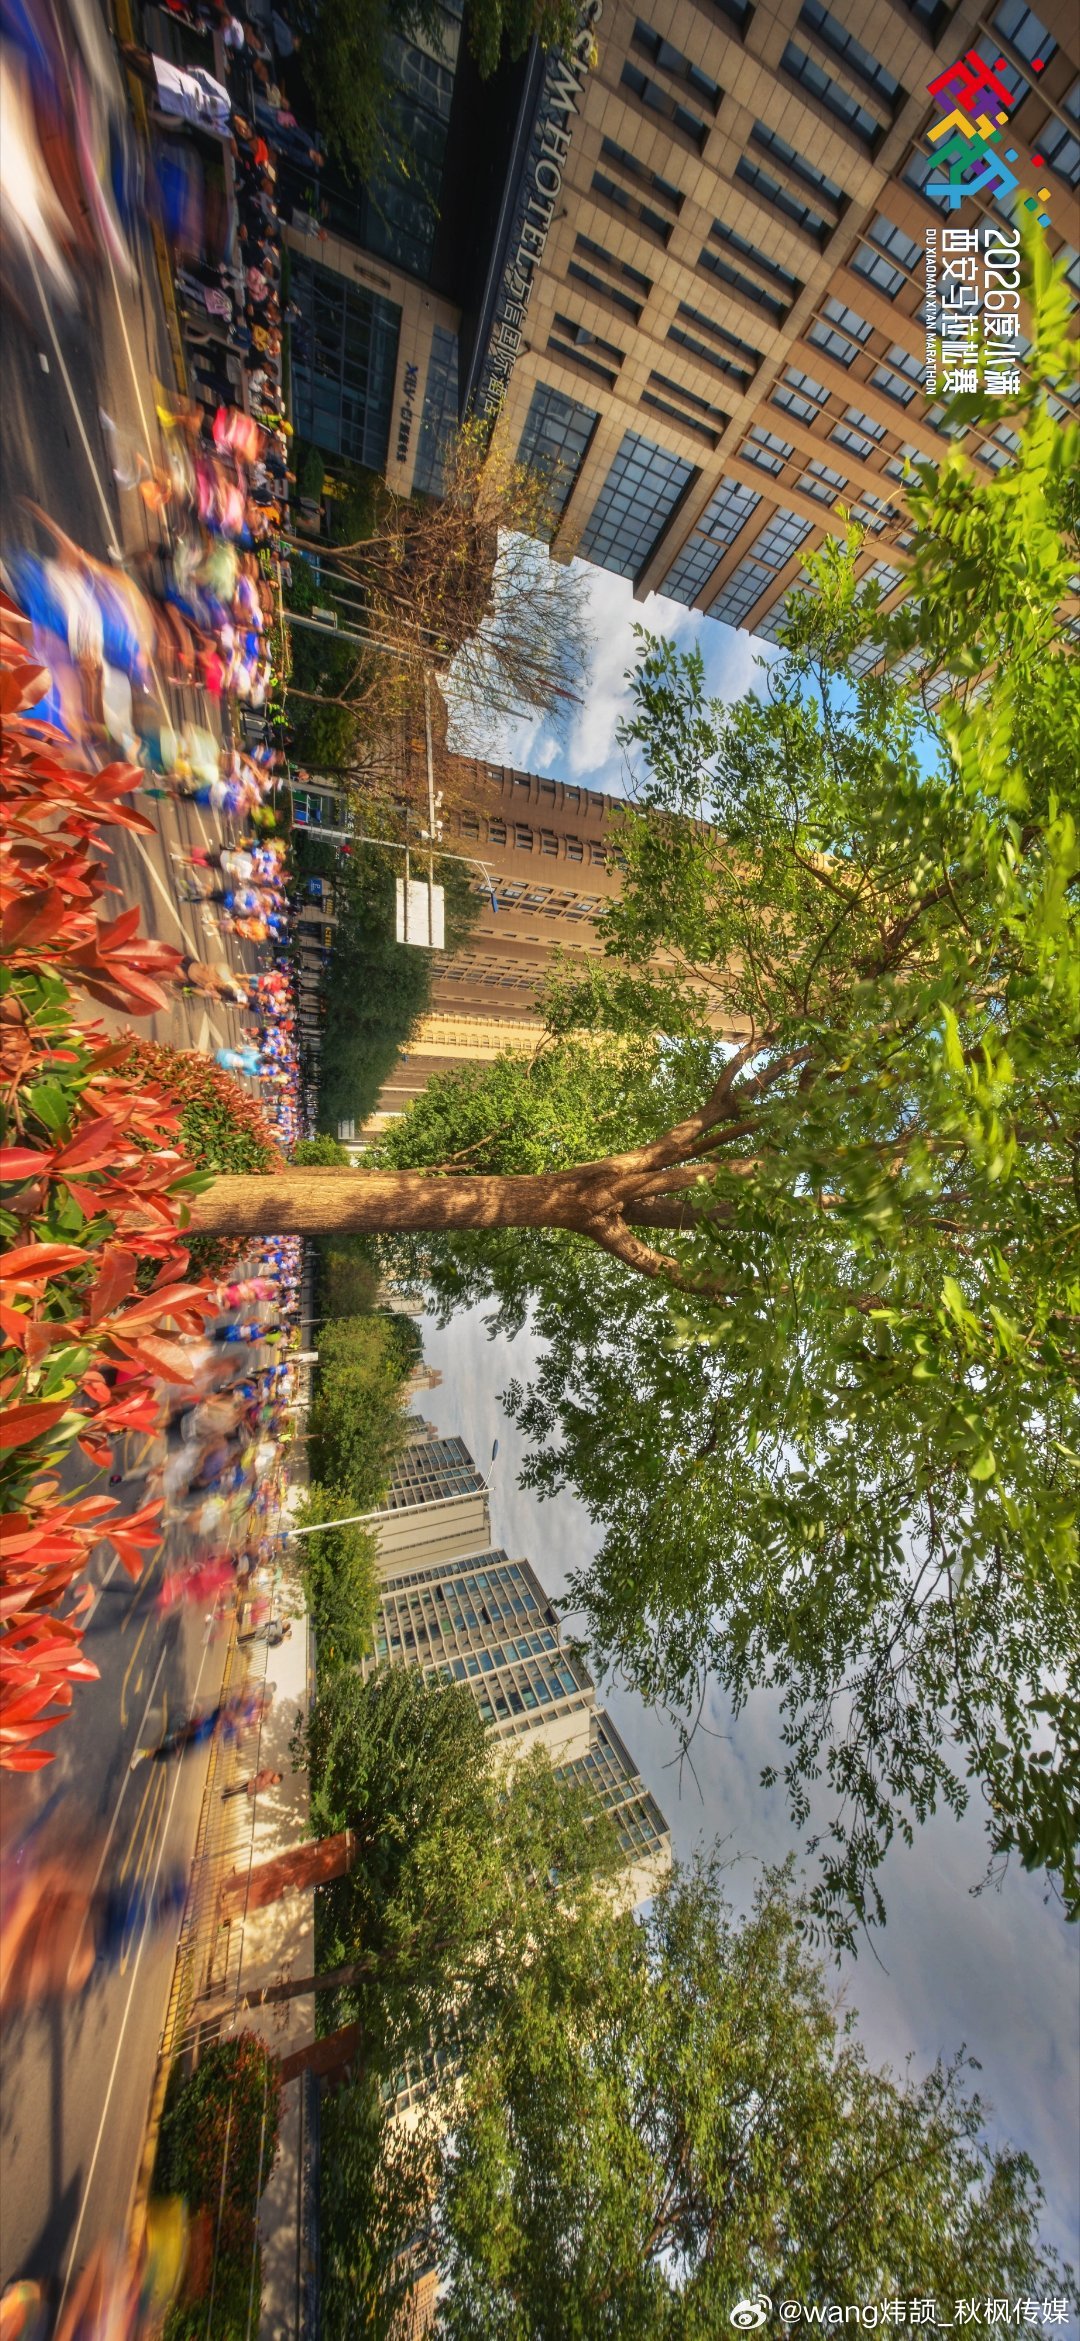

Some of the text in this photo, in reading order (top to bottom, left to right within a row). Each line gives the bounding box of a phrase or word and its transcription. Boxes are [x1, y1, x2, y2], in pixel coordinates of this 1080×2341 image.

[516, 118, 572, 267] HOTEL
[483, 267, 534, 419] 万信国际酒店
